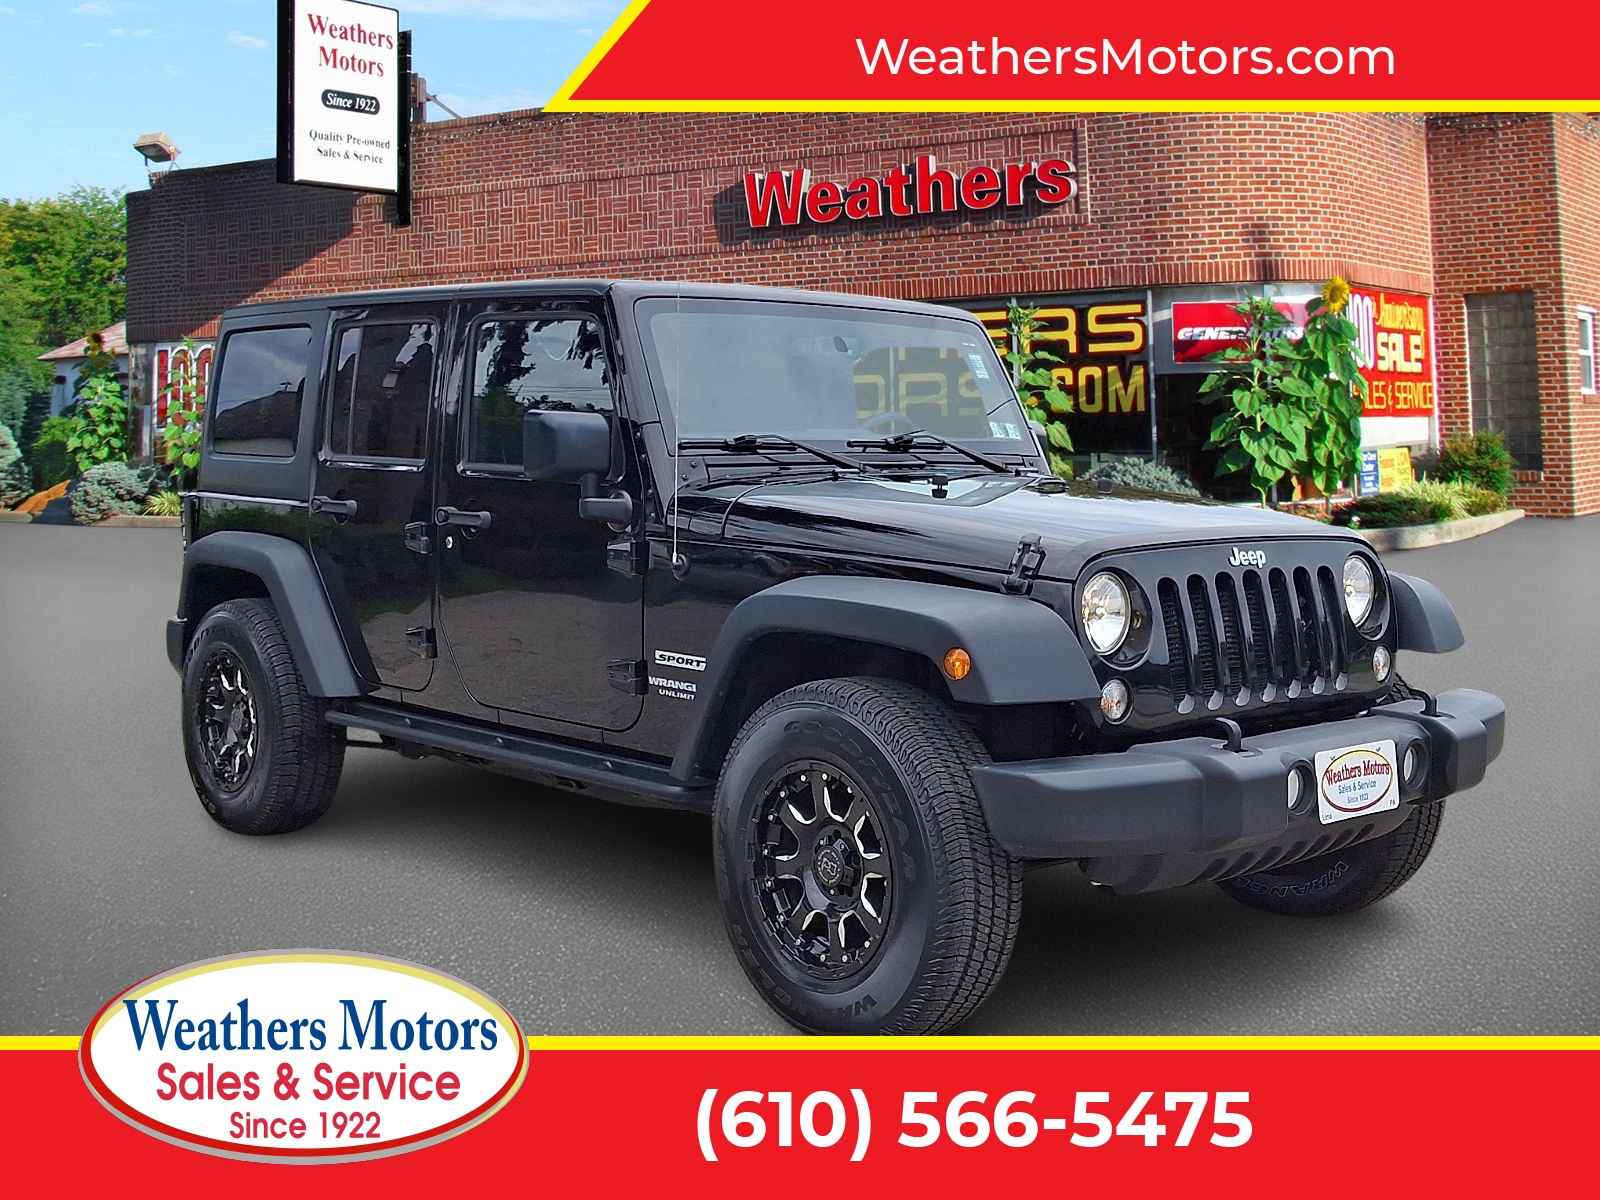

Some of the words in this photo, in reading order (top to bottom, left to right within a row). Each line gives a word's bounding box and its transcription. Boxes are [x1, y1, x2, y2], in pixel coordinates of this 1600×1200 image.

[307, 13, 394, 50] Weathers
[318, 45, 384, 77] Motors
[326, 92, 353, 109] Since
[355, 97, 376, 112] 1922
[309, 128, 343, 145] Quality
[346, 133, 391, 150] Pre-owned
[317, 146, 341, 159] Sales
[343, 150, 351, 160] &
[353, 151, 384, 164] Service
[743, 154, 1078, 229] Weathers
[1376, 332, 1423, 373] SALE
[1352, 381, 1386, 410] LES
[1394, 381, 1433, 410] SERVICE
[1229, 546, 1267, 569] Jeep
[658, 653, 703, 668] SPORT
[1325, 763, 1362, 787] Weathers
[1362, 759, 1391, 777] Motors
[1338, 783, 1352, 795] Sales
[1358, 779, 1377, 791] Service
